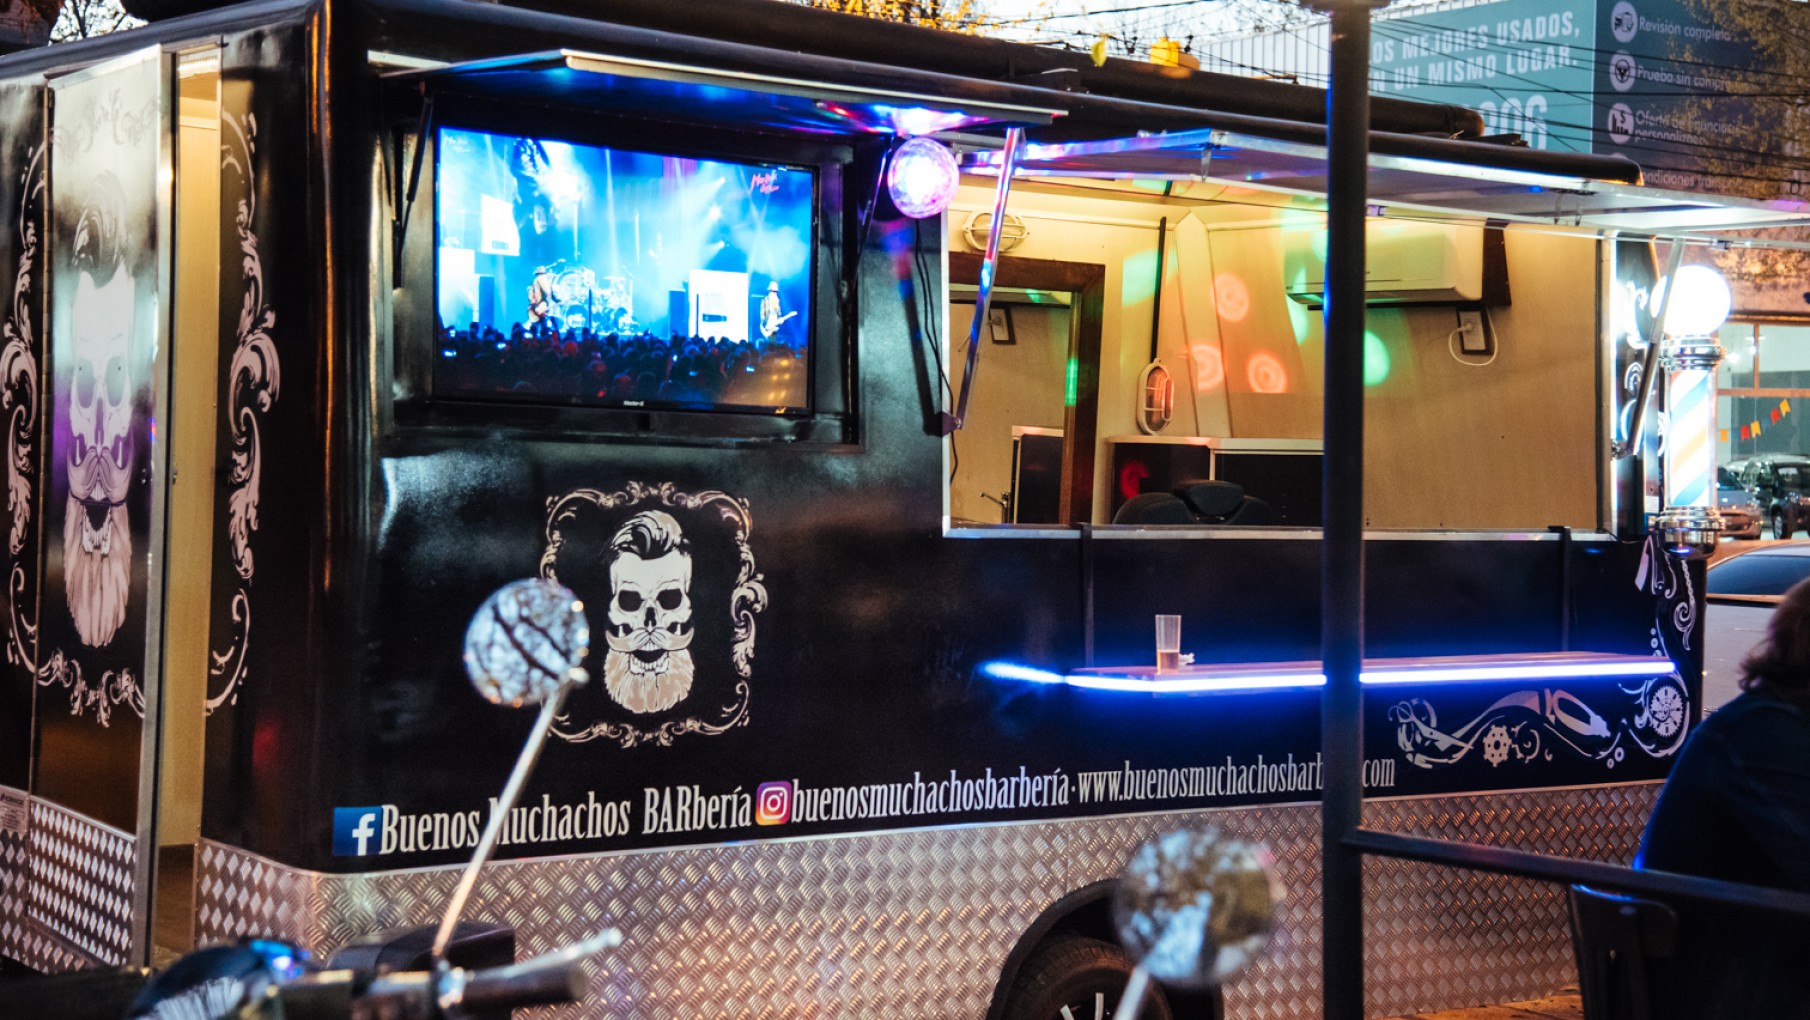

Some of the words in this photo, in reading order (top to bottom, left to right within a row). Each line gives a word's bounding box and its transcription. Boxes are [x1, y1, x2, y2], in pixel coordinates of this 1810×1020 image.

[1369, 39, 1394, 64] OS
[1402, 25, 1489, 60] MEJORES
[1496, 11, 1580, 46] USADOS,
[1639, 16, 1681, 37] Revisión
[1366, 69, 1386, 93] N
[1394, 65, 1419, 91] UN
[1428, 54, 1496, 86] MISMO
[1506, 44, 1579, 75] LUGAR.
[1637, 65, 1674, 83] Prueba
[1676, 70, 1691, 87] sin
[1641, 169, 1695, 188] ondiciones
[380, 804, 480, 855] Buenos
[642, 784, 752, 835] BARbería
[791, 766, 1069, 824] buenosmuchachosbarbería
[1078, 752, 1396, 804] www.buenosmuchachosbarbcom
